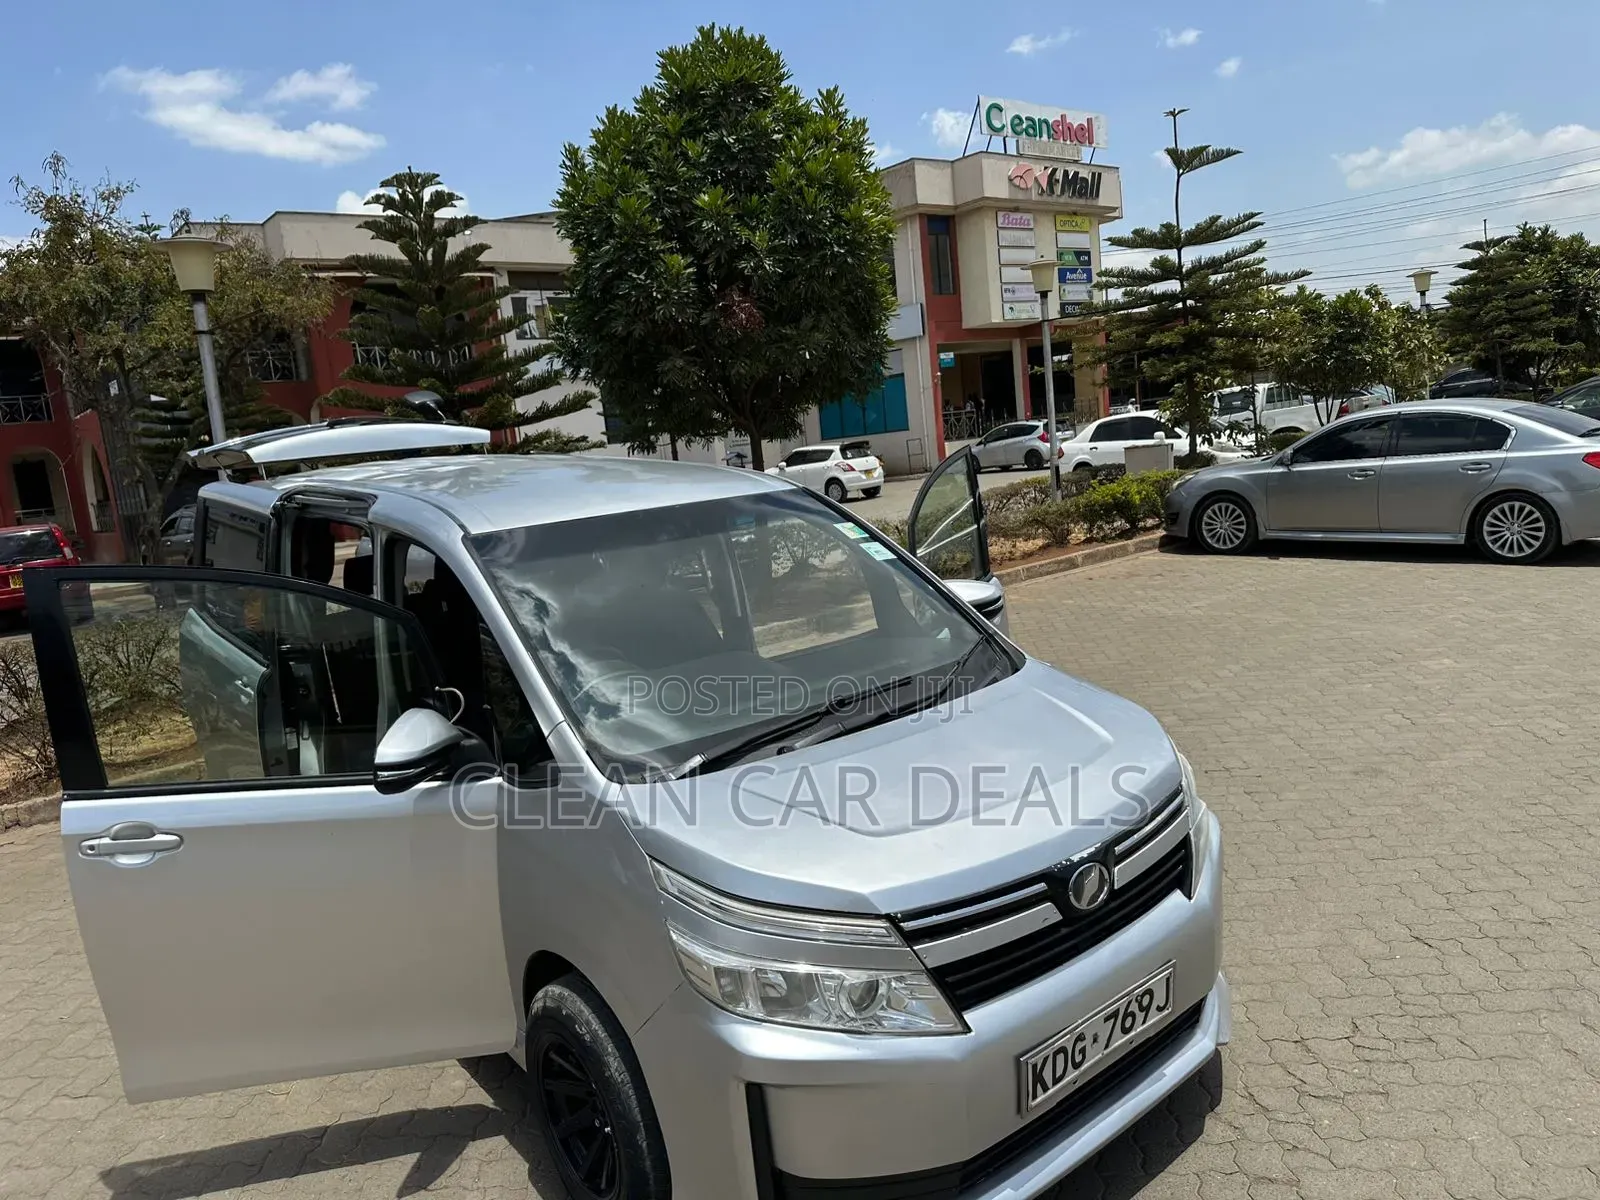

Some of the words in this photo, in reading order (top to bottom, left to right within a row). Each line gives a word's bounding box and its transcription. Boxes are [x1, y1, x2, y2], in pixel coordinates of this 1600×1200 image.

[1001, 213, 1031, 227] Bata
[1066, 270, 1087, 280] Avenue
[1031, 1032, 1087, 1100] KDG
[1103, 976, 1170, 1051] 769J
